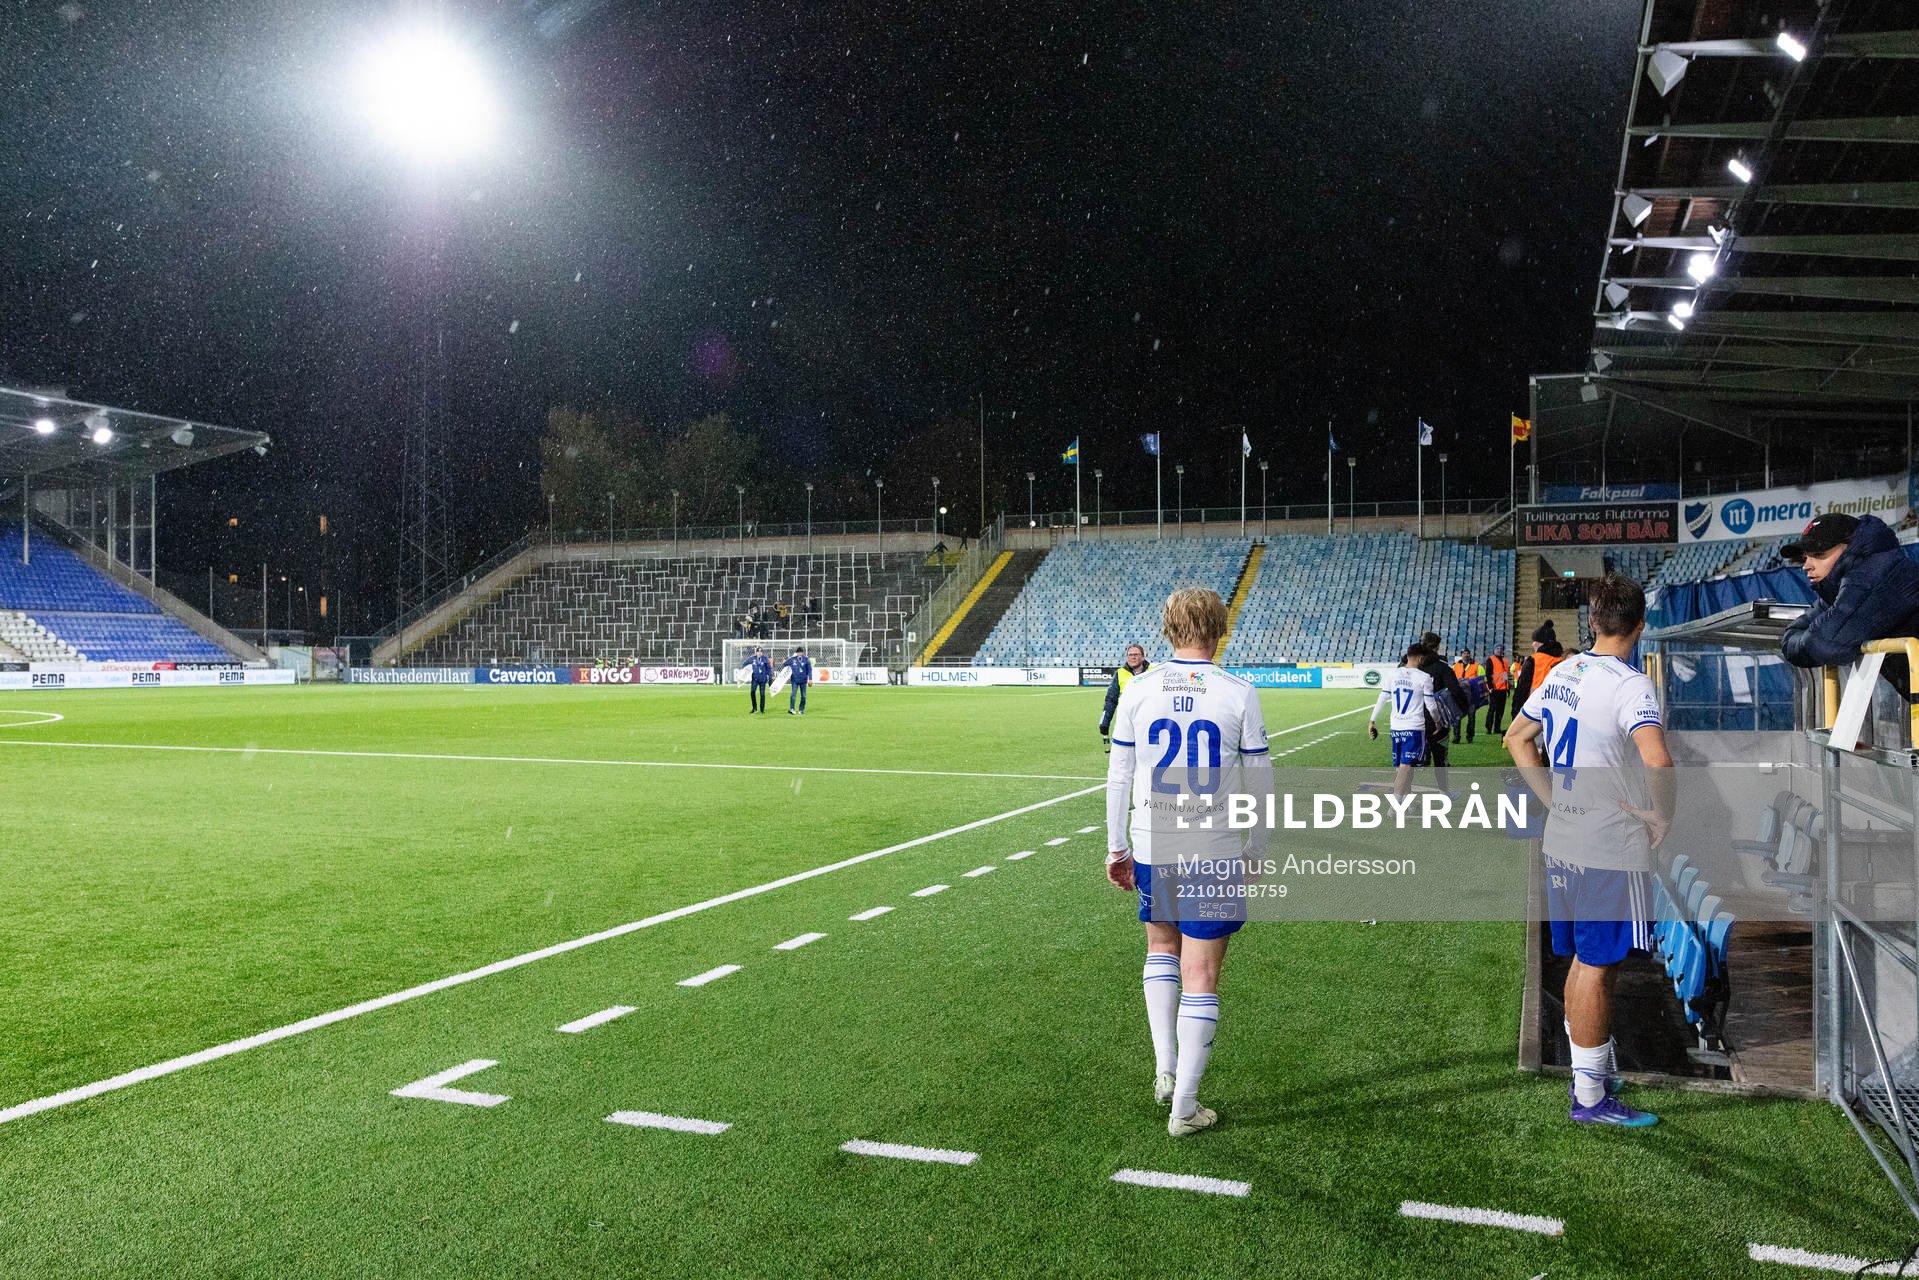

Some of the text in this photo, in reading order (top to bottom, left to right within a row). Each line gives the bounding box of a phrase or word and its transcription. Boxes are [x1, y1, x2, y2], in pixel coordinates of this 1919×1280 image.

[1525, 524, 1572, 541] LIKA
[1577, 522, 1622, 541] SOM
[32, 673, 65, 684] PEMA
[132, 672, 161, 683] PEMA
[219, 671, 245, 681] PEMA
[350, 667, 471, 683] Fiskarhedenvillan
[489, 668, 556, 683] Caverion
[921, 671, 978, 682] HOLMEN
[1162, 685, 1208, 695] Norrköping
[1541, 683, 1581, 711] RIKSSON
[1173, 695, 1194, 712] EID
[1393, 687, 1414, 715] 17
[1147, 717, 1222, 797] 20
